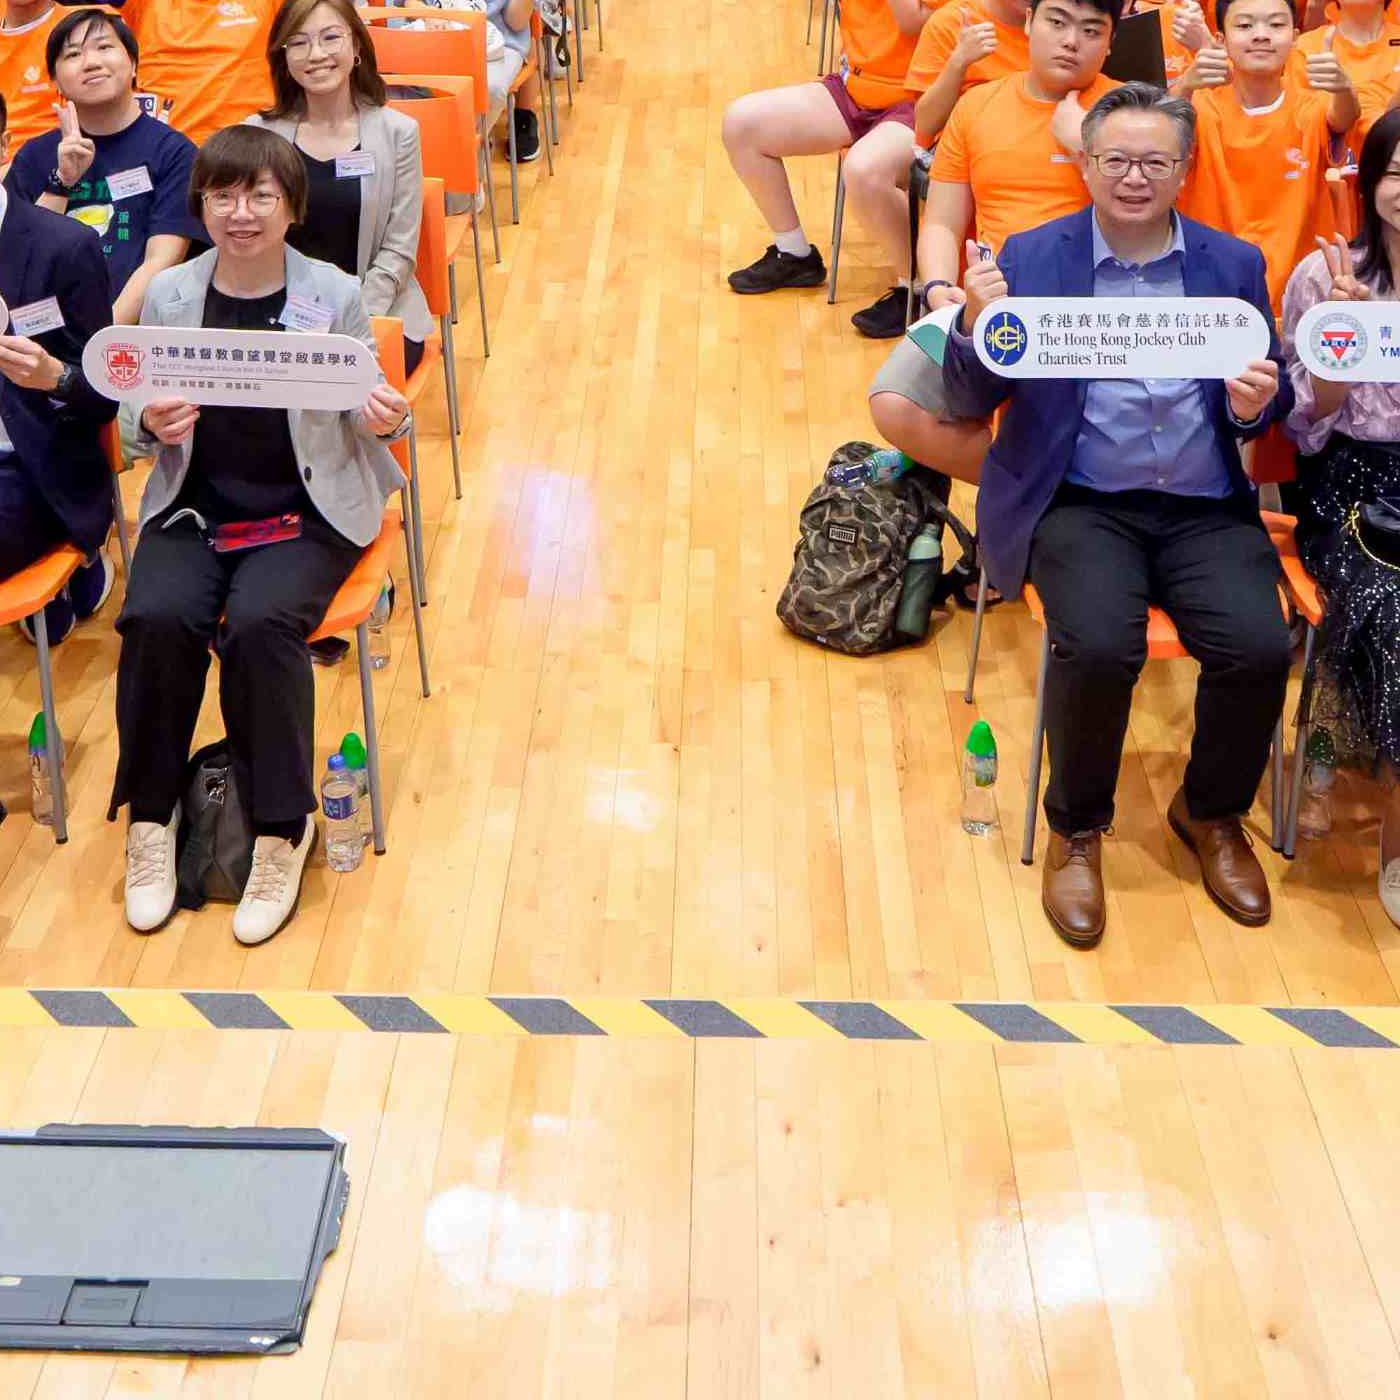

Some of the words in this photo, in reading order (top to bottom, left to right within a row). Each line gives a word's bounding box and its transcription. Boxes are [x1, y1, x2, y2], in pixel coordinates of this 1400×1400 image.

[1038, 313, 1249, 328] 香港賽馬會慈善信託基金
[1037, 332, 1061, 346] The
[1064, 333, 1097, 350] Hong
[1100, 333, 1131, 350] Kong
[1134, 333, 1175, 350] Jockey
[1178, 332, 1206, 346] Club
[1038, 351, 1091, 366] Charities
[1096, 352, 1127, 366] Trust
